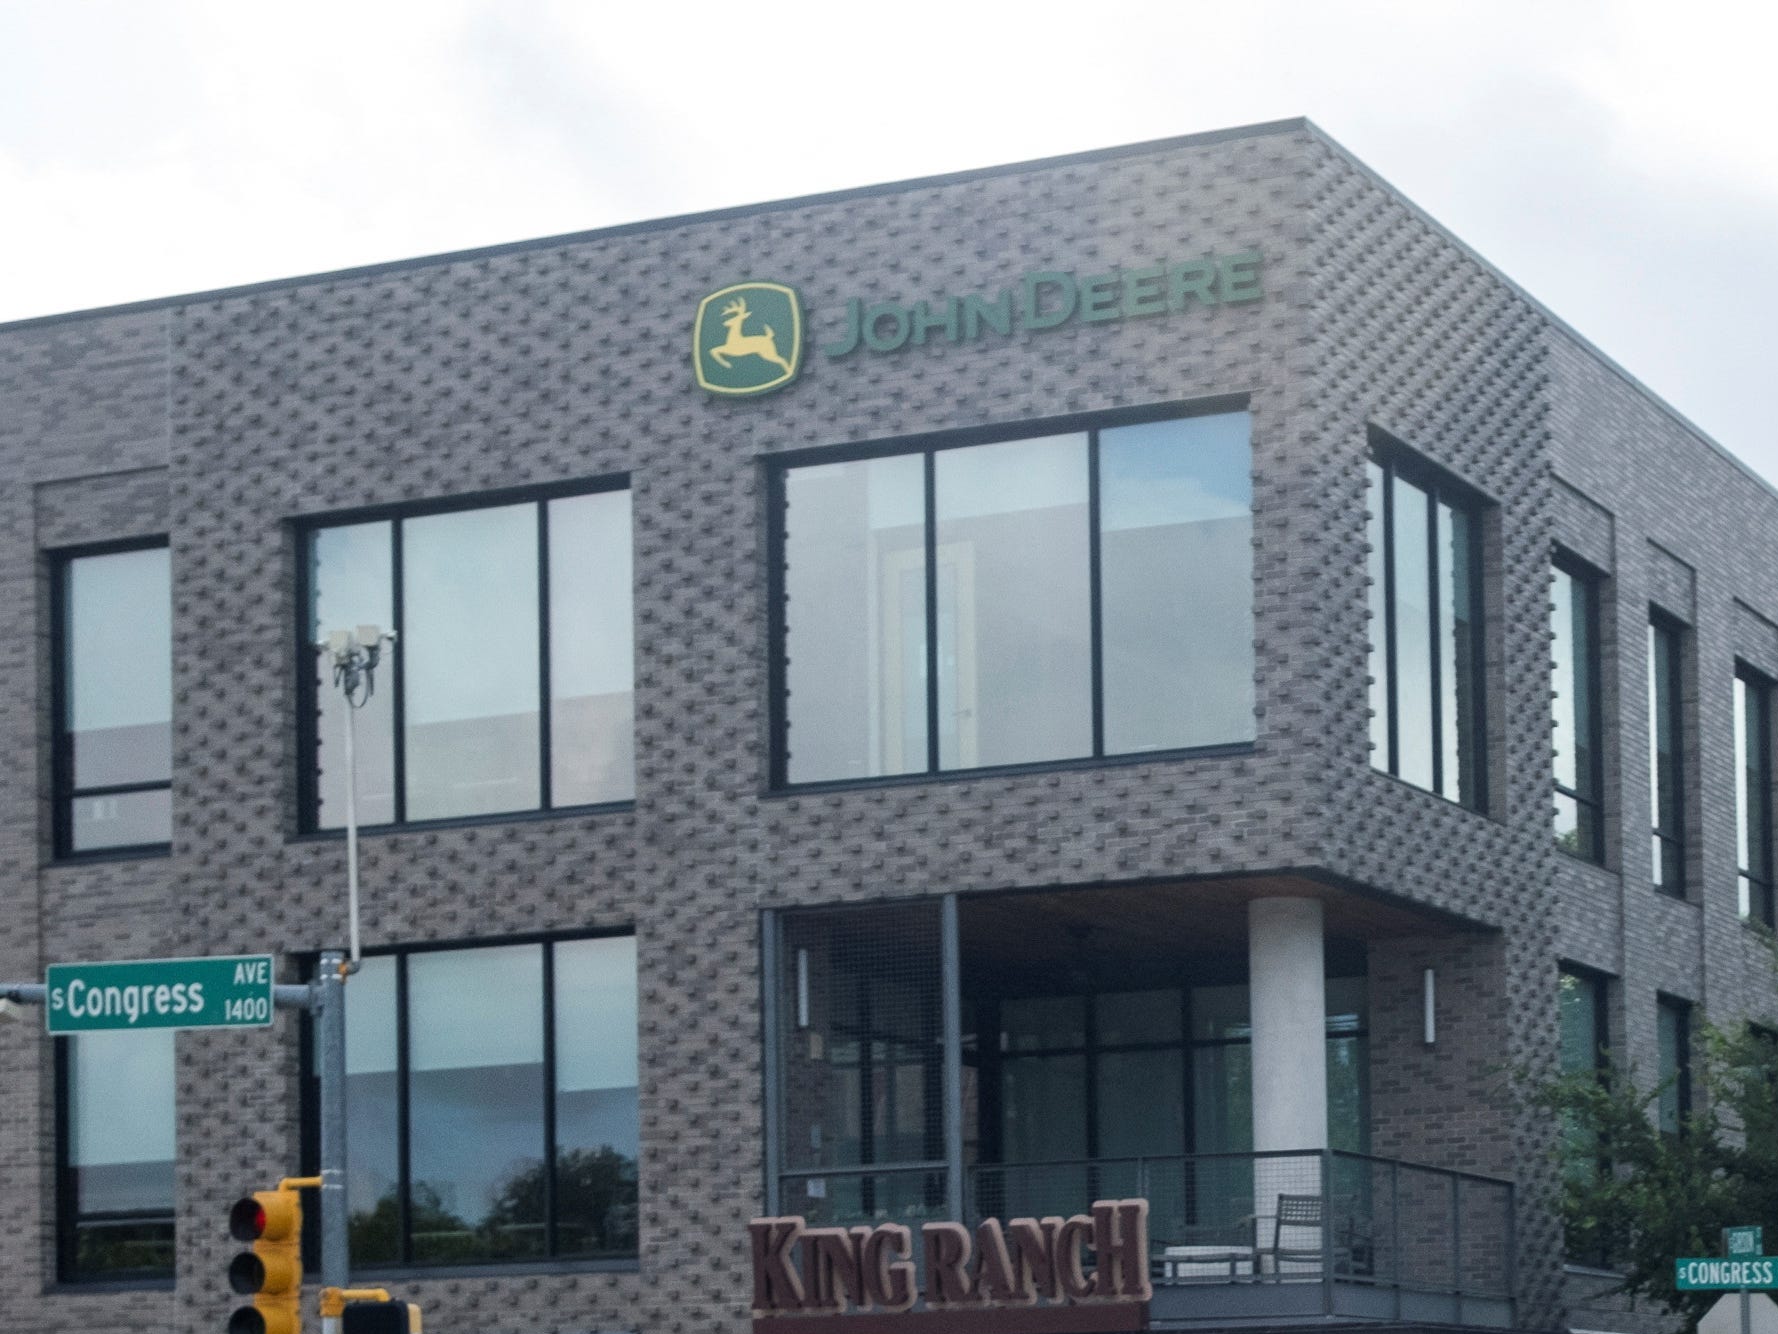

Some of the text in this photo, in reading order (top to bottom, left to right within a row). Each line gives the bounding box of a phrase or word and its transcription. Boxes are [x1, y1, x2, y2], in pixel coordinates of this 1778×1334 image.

[825, 251, 1266, 358] JOHN DEERE
[234, 962, 268, 984] AVE
[52, 979, 205, 1024] S Congress
[225, 998, 267, 1020] 1400
[748, 1199, 1152, 1318] KING RANCH
[1679, 1261, 1774, 1284] S CONGRESS
